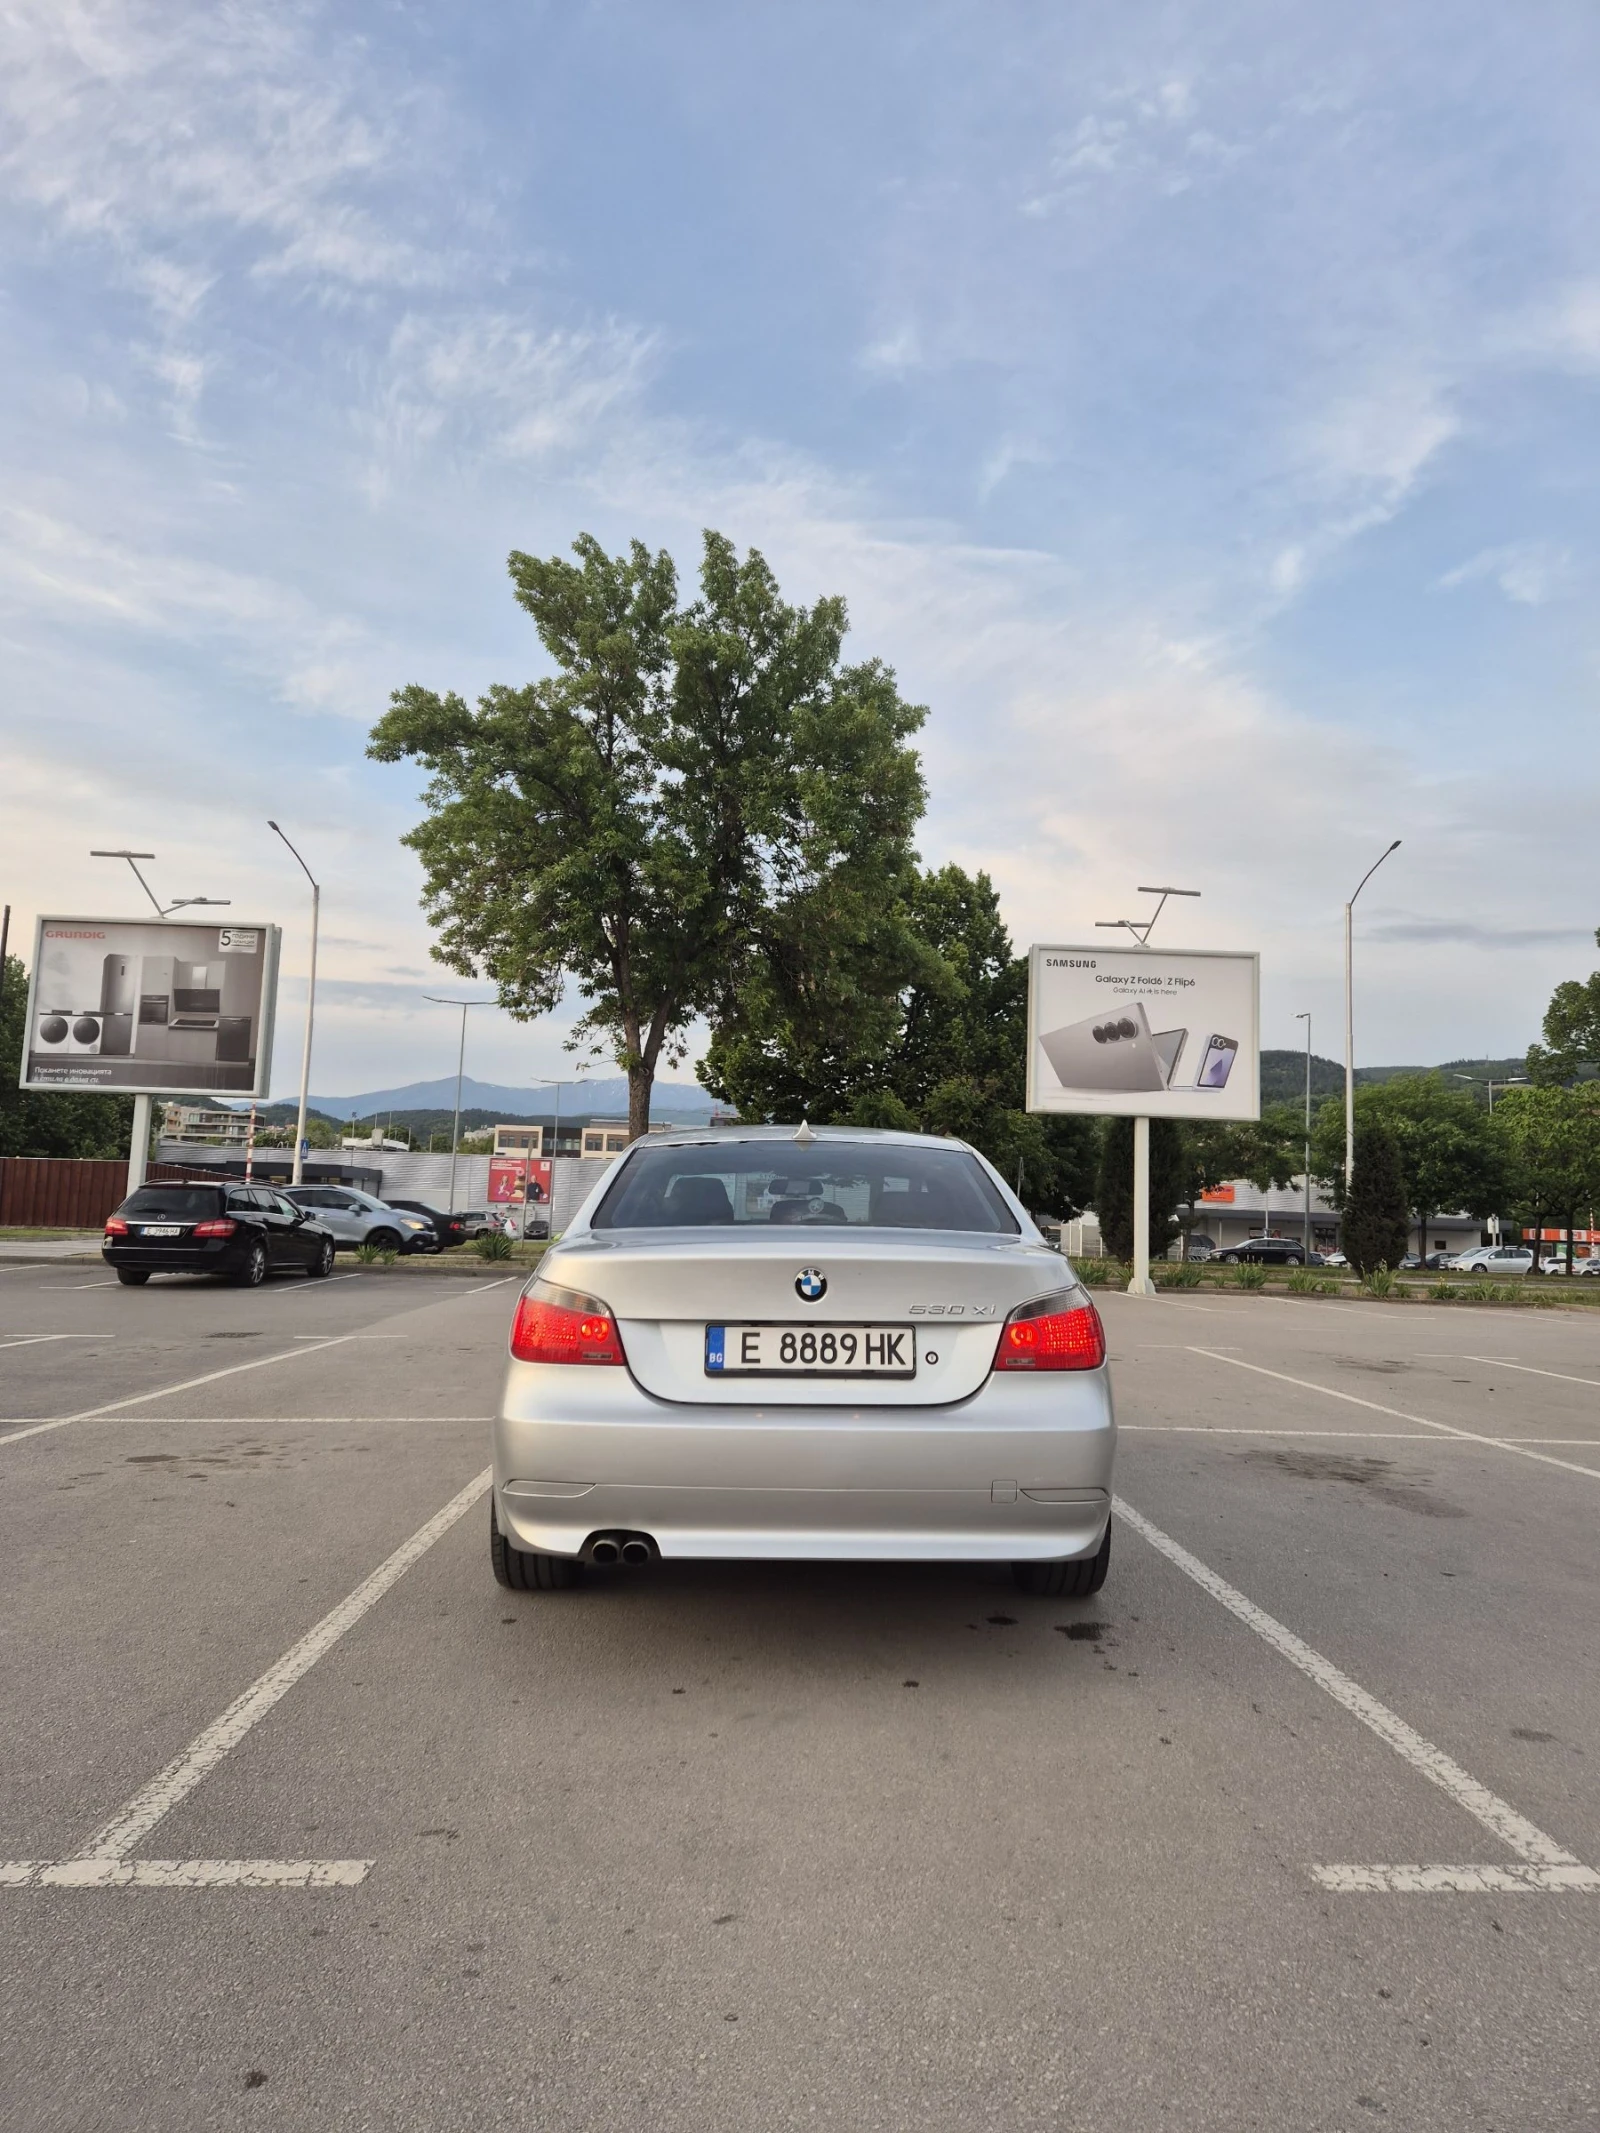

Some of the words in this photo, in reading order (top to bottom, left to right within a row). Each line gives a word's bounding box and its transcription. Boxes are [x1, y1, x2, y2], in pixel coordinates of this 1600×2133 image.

[45, 931, 106, 939] GRUNDIG
[221, 930, 231, 946] 5
[1046, 958, 1097, 969] SAMSUNG
[1095, 975, 1129, 985] Galaxy
[1130, 976, 1136, 984] Z
[1137, 976, 1163, 985] Fold6
[1167, 977, 1173, 986] Z
[1174, 978, 1196, 988] Flip6
[1113, 986, 1137, 995] Galaxy
[34, 1066, 69, 1075] Поканете
[69, 1068, 112, 1076] иновацията
[909, 1304, 965, 1315] 530
[973, 1304, 996, 1316] xi
[741, 1332, 761, 1364] E
[779, 1332, 858, 1365] 8889
[865, 1333, 906, 1366] HK
[709, 1352, 723, 1363] BG
